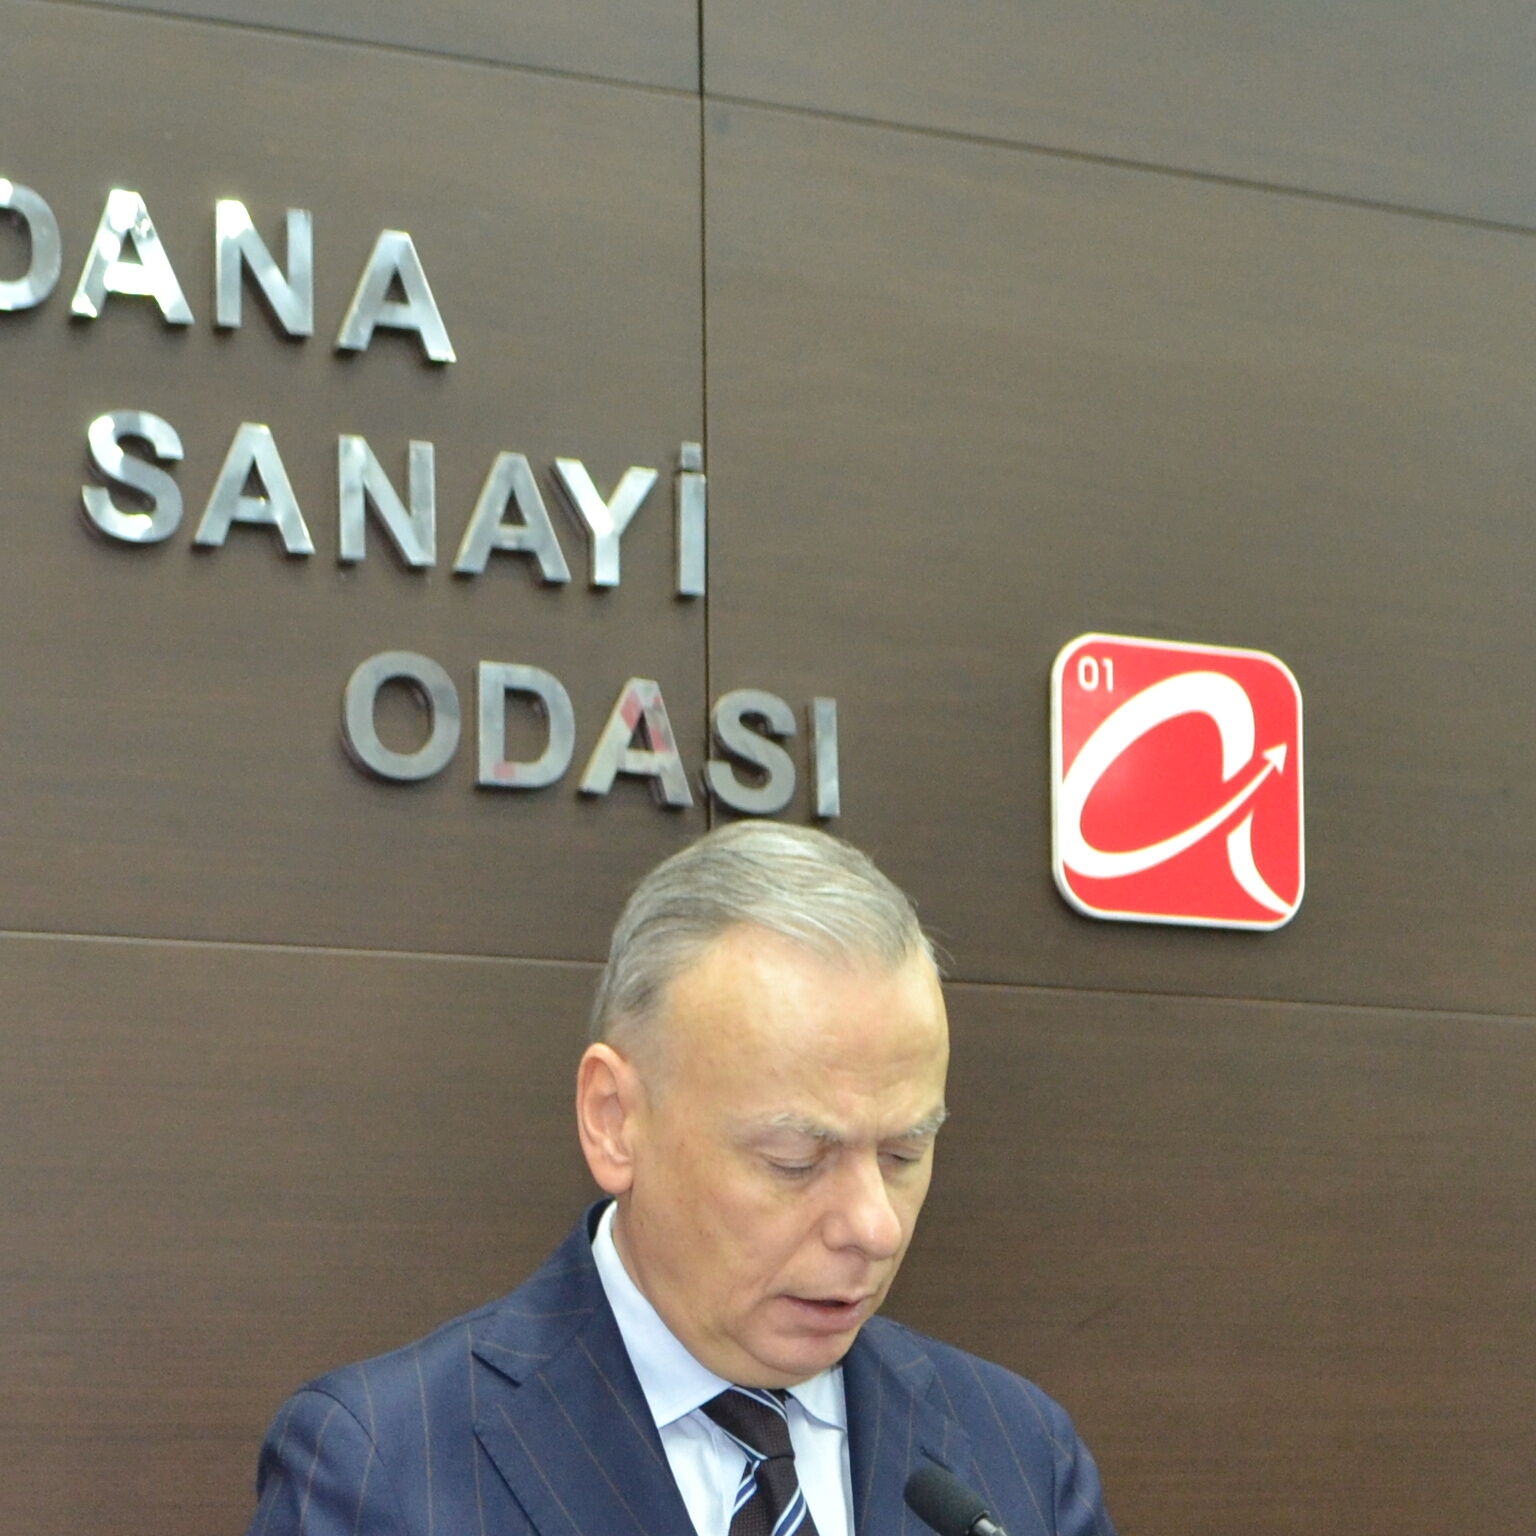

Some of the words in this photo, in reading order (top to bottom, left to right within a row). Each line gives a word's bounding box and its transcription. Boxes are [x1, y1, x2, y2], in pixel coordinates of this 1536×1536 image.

[80, 410, 705, 599] SANAYİ
[340, 651, 841, 818] ODASI
[1077, 655, 1114, 693] 01
